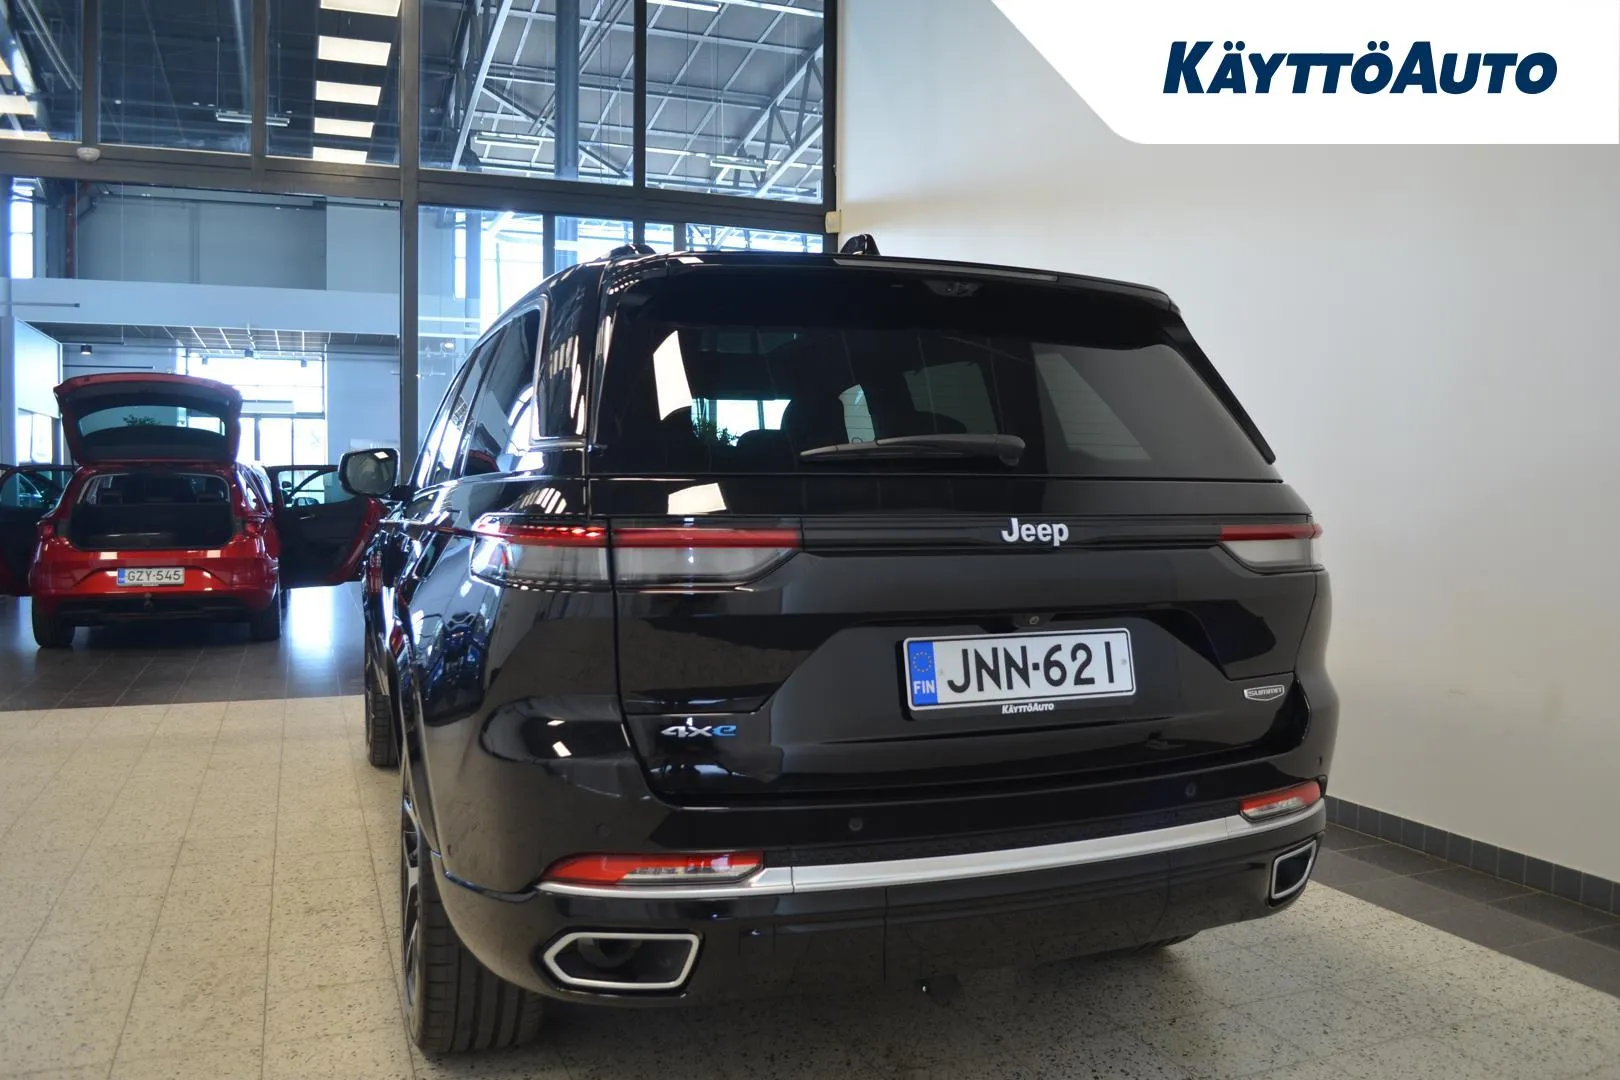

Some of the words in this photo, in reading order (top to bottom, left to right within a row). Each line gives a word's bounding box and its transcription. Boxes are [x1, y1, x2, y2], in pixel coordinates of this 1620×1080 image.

[1002, 518, 1069, 547] Jeep
[127, 570, 181, 581] GZY-545
[947, 640, 1115, 694] JNN-621
[913, 679, 936, 696] FIN
[1001, 702, 1055, 714] KÄYTTÖAUTO
[661, 725, 737, 738] 4xe
